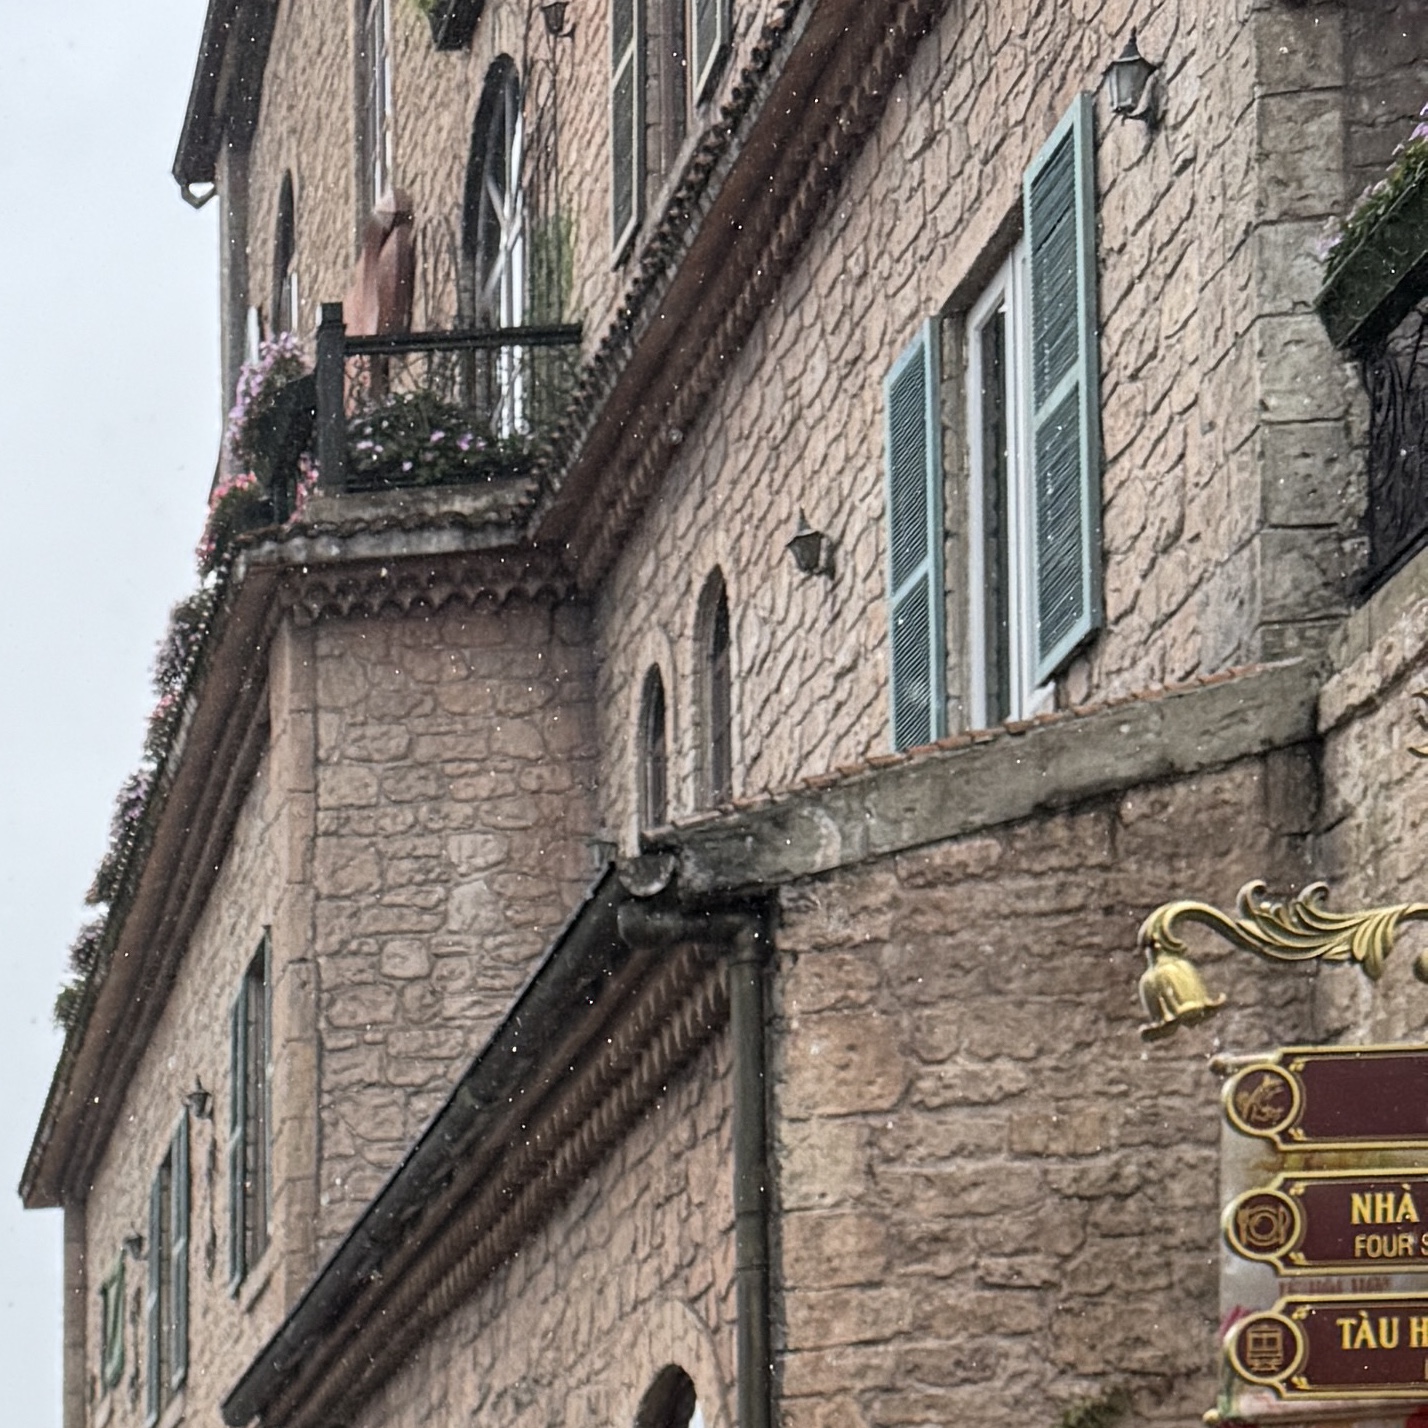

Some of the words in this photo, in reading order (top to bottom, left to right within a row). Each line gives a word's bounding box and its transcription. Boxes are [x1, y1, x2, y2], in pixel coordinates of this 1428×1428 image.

[1350, 1183, 1420, 1225] NHÀ
[1354, 1233, 1414, 1258] FOUR
[1336, 1309, 1399, 1350] TÀU
